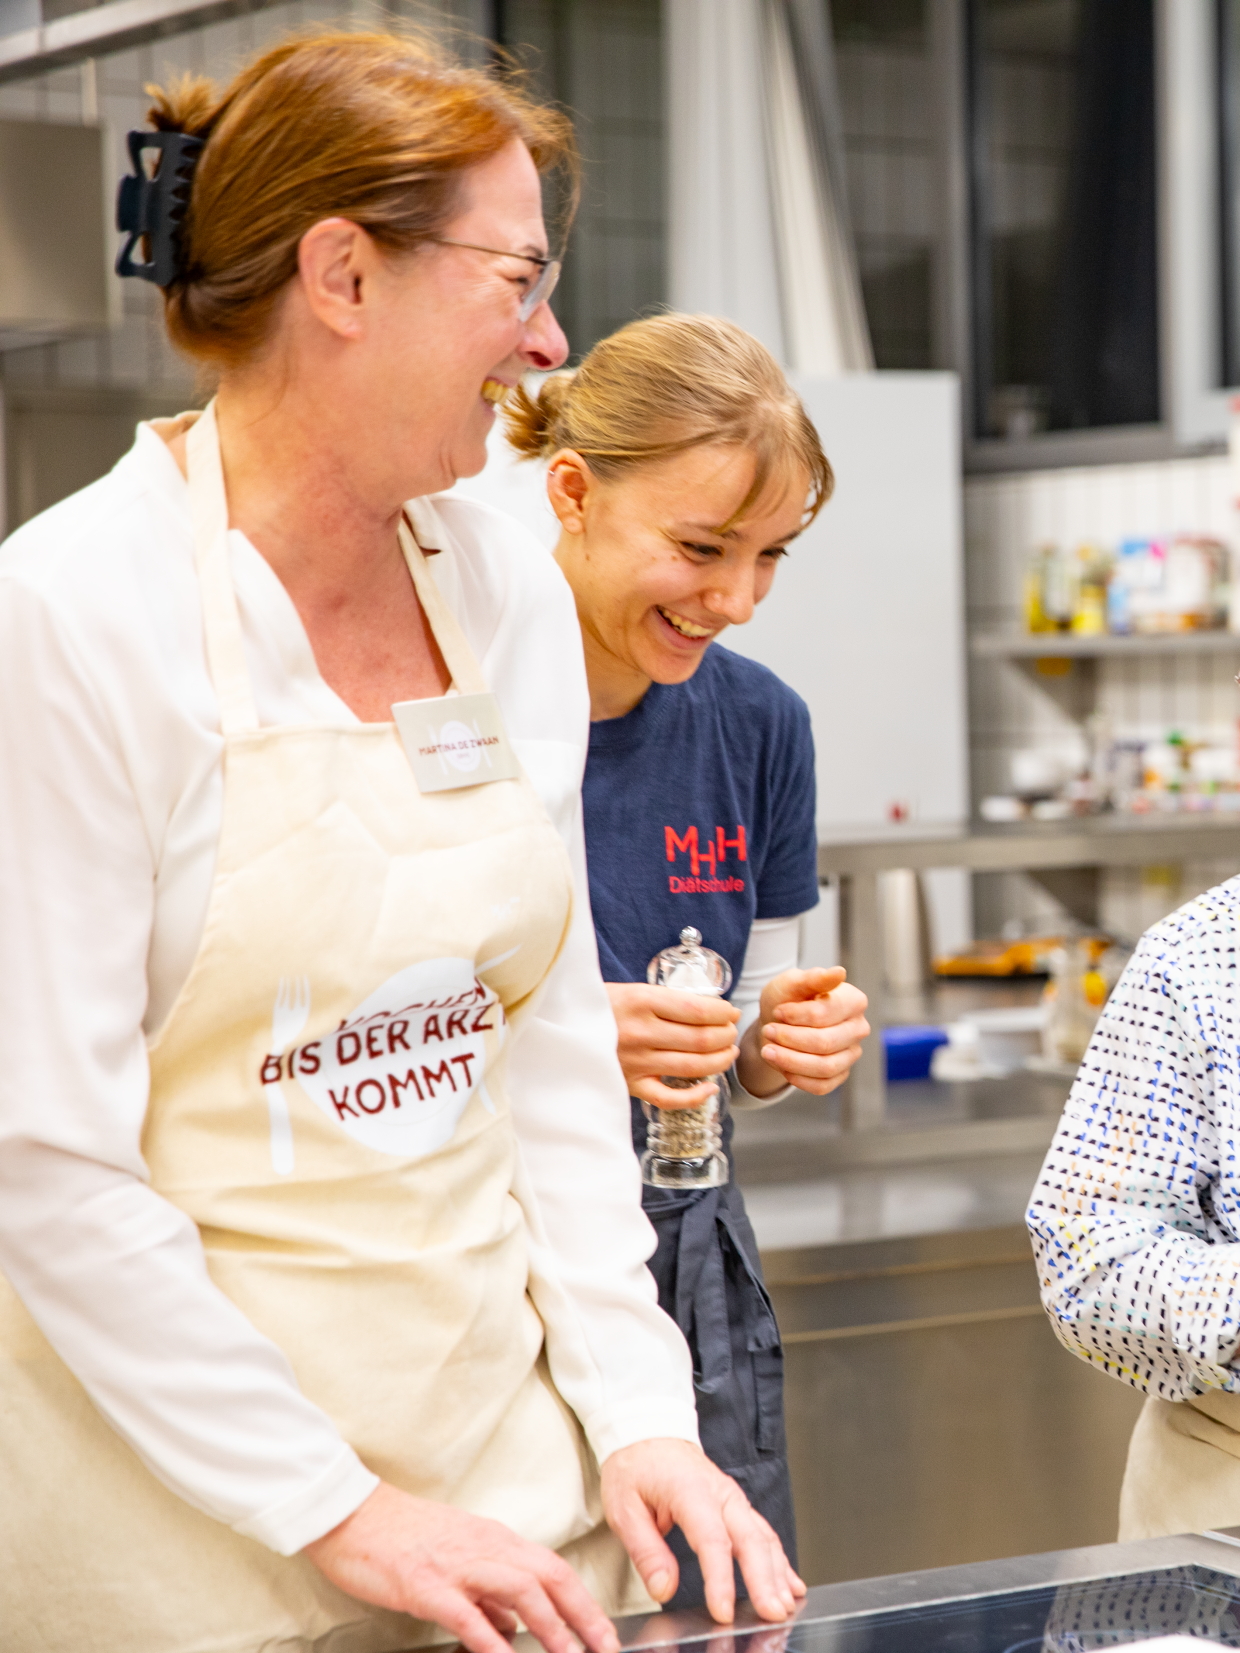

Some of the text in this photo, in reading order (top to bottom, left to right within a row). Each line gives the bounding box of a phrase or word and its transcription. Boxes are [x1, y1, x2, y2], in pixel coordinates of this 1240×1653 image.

[418, 744, 457, 756] MARTINA
[458, 741, 469, 750] DE
[469, 736, 499, 748] ZWAAN
[664, 825, 747, 876] MHH
[260, 1002, 505, 1085] BIS DER ARZ
[328, 1052, 475, 1121] KOMMT
